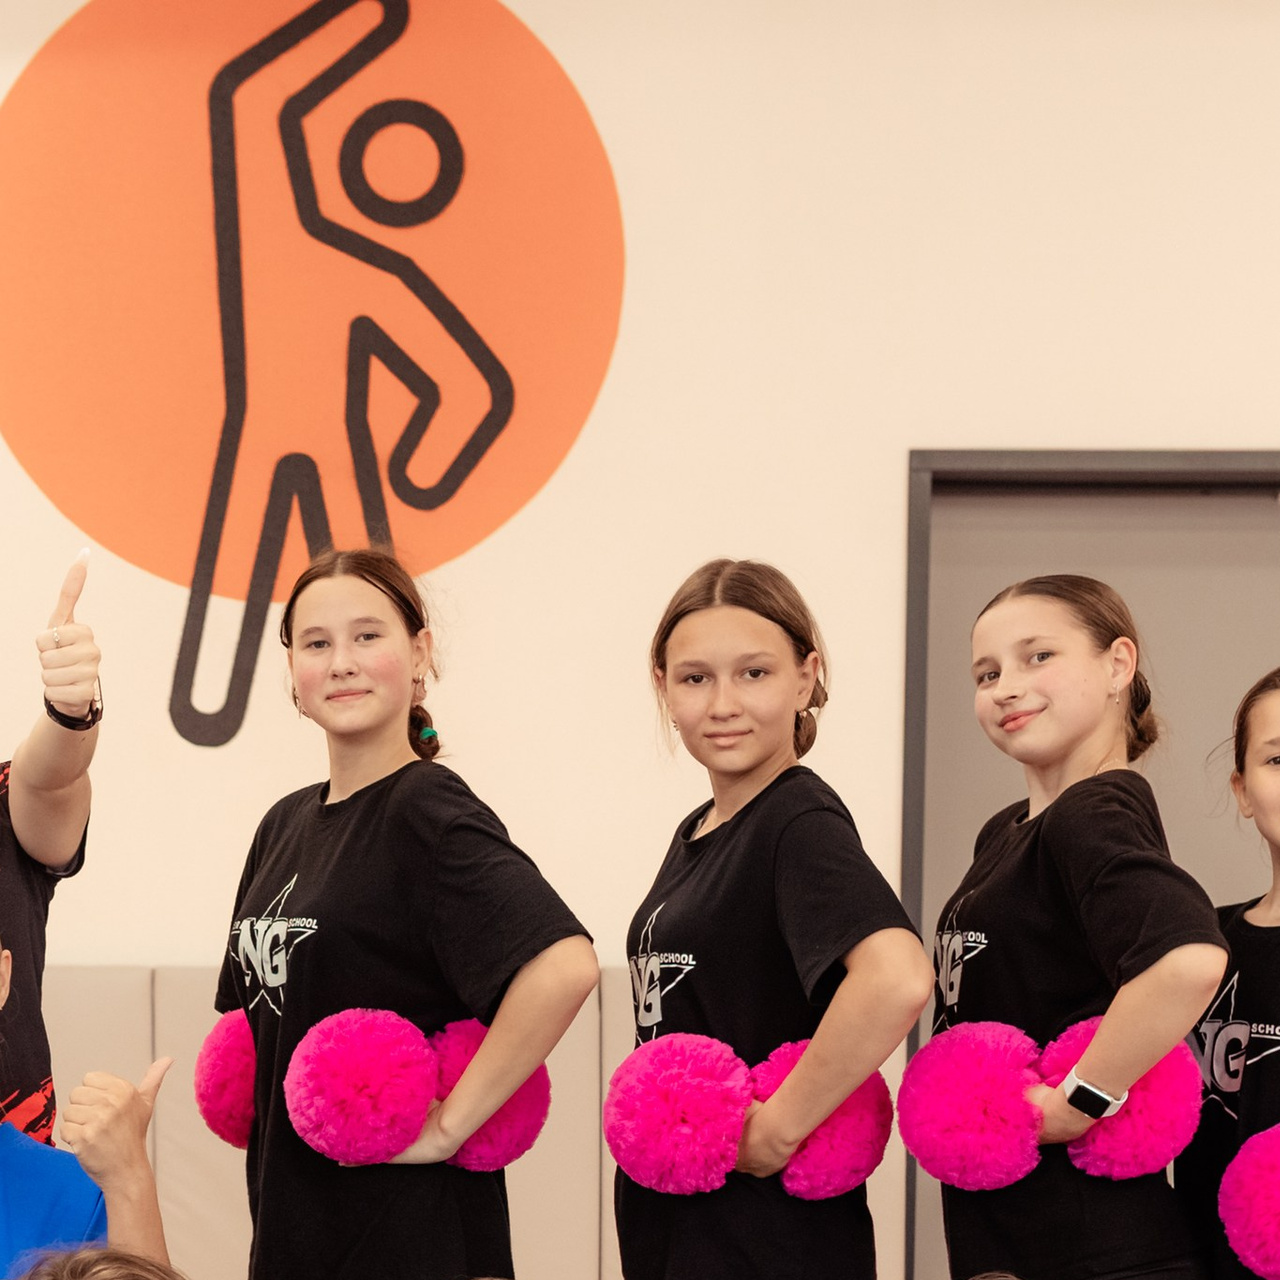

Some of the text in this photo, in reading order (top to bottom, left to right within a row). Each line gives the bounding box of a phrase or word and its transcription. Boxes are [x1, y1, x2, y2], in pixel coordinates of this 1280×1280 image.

[238, 916, 318, 987] NG SCHOOL
[659, 952, 696, 965] SCHOOL
